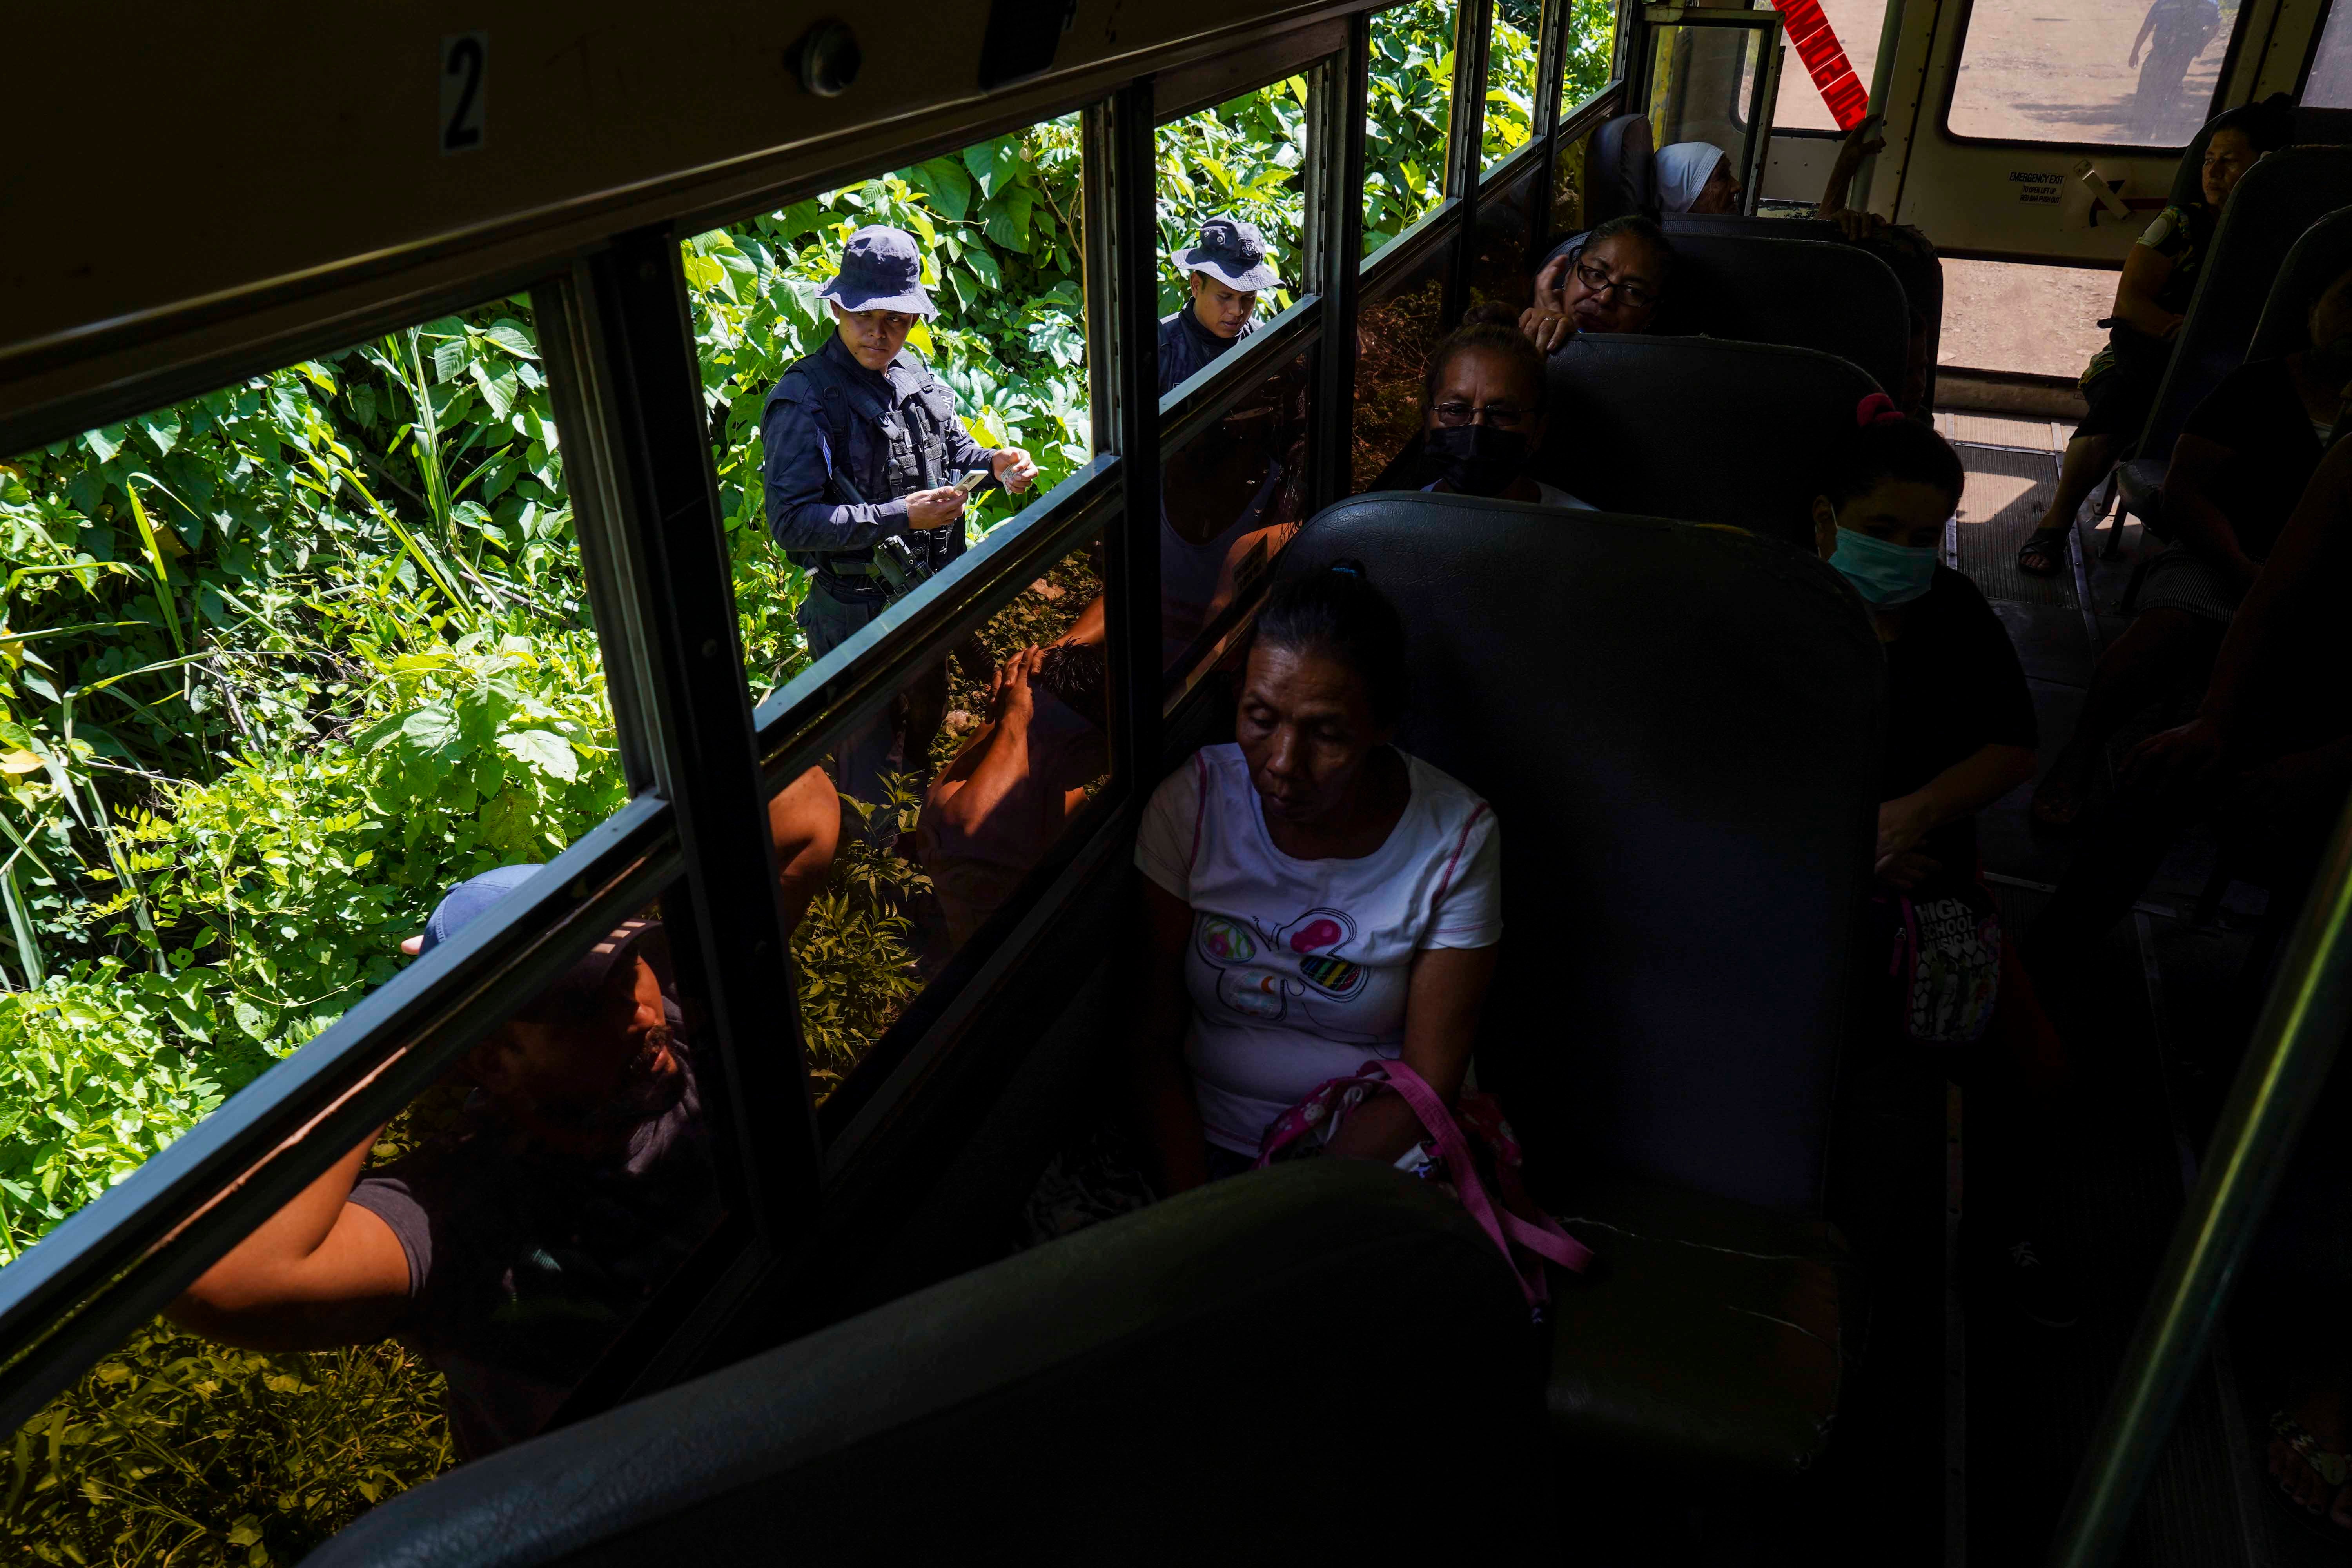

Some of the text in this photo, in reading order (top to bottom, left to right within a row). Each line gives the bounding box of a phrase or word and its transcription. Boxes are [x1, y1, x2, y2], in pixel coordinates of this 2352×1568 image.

[445, 38, 480, 147] 2
[2009, 172, 2064, 184] EMERGENCY EXIT
[1915, 898, 1973, 924] HIGH
[1922, 916, 1976, 941] SCHOOL
